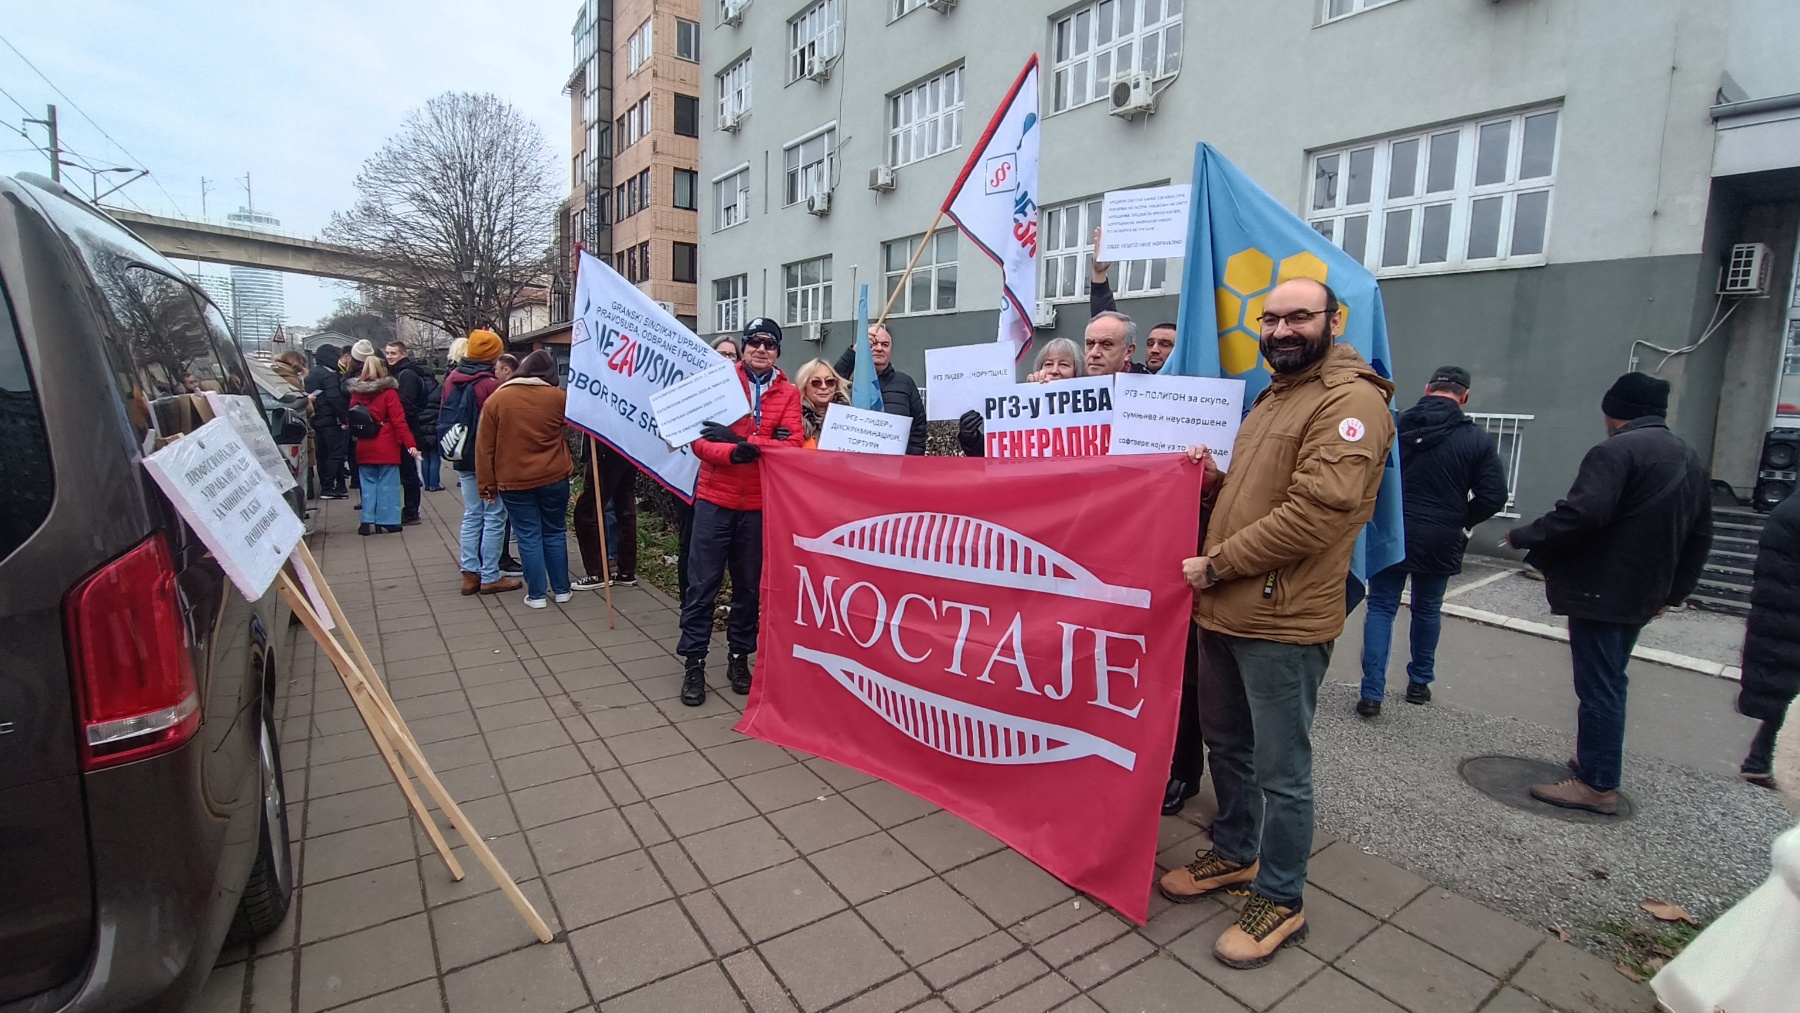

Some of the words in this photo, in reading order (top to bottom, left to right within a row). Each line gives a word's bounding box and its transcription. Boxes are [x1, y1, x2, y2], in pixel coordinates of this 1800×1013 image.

[611, 301, 643, 323] GRANSKI
[643, 316, 677, 340] SINDIKAT
[677, 334, 708, 357] UPRAVE
[642, 329, 678, 355] ODBRANE
[944, 373, 964, 381] ЛИДЕР
[611, 392, 637, 422] RGZ
[985, 394, 1040, 420] РГЗ-у
[1045, 387, 1113, 415] ТРЕБА
[1125, 389, 1138, 398] РГЗ
[1145, 390, 1186, 401] ПОЛИГОН
[1200, 396, 1230, 406] скупе,
[864, 417, 890, 428] ЛИДЕР
[1166, 415, 1227, 427] неусавршене
[848, 437, 880, 449] ТОРТУРИ
[1151, 441, 1166, 450] који
[185, 441, 241, 487] ПРОФЕСИОНАЛНА
[201, 473, 229, 502] УПРАВА
[212, 505, 226, 521] ЗА
[793, 564, 1147, 719] МОСТАЈЕ
